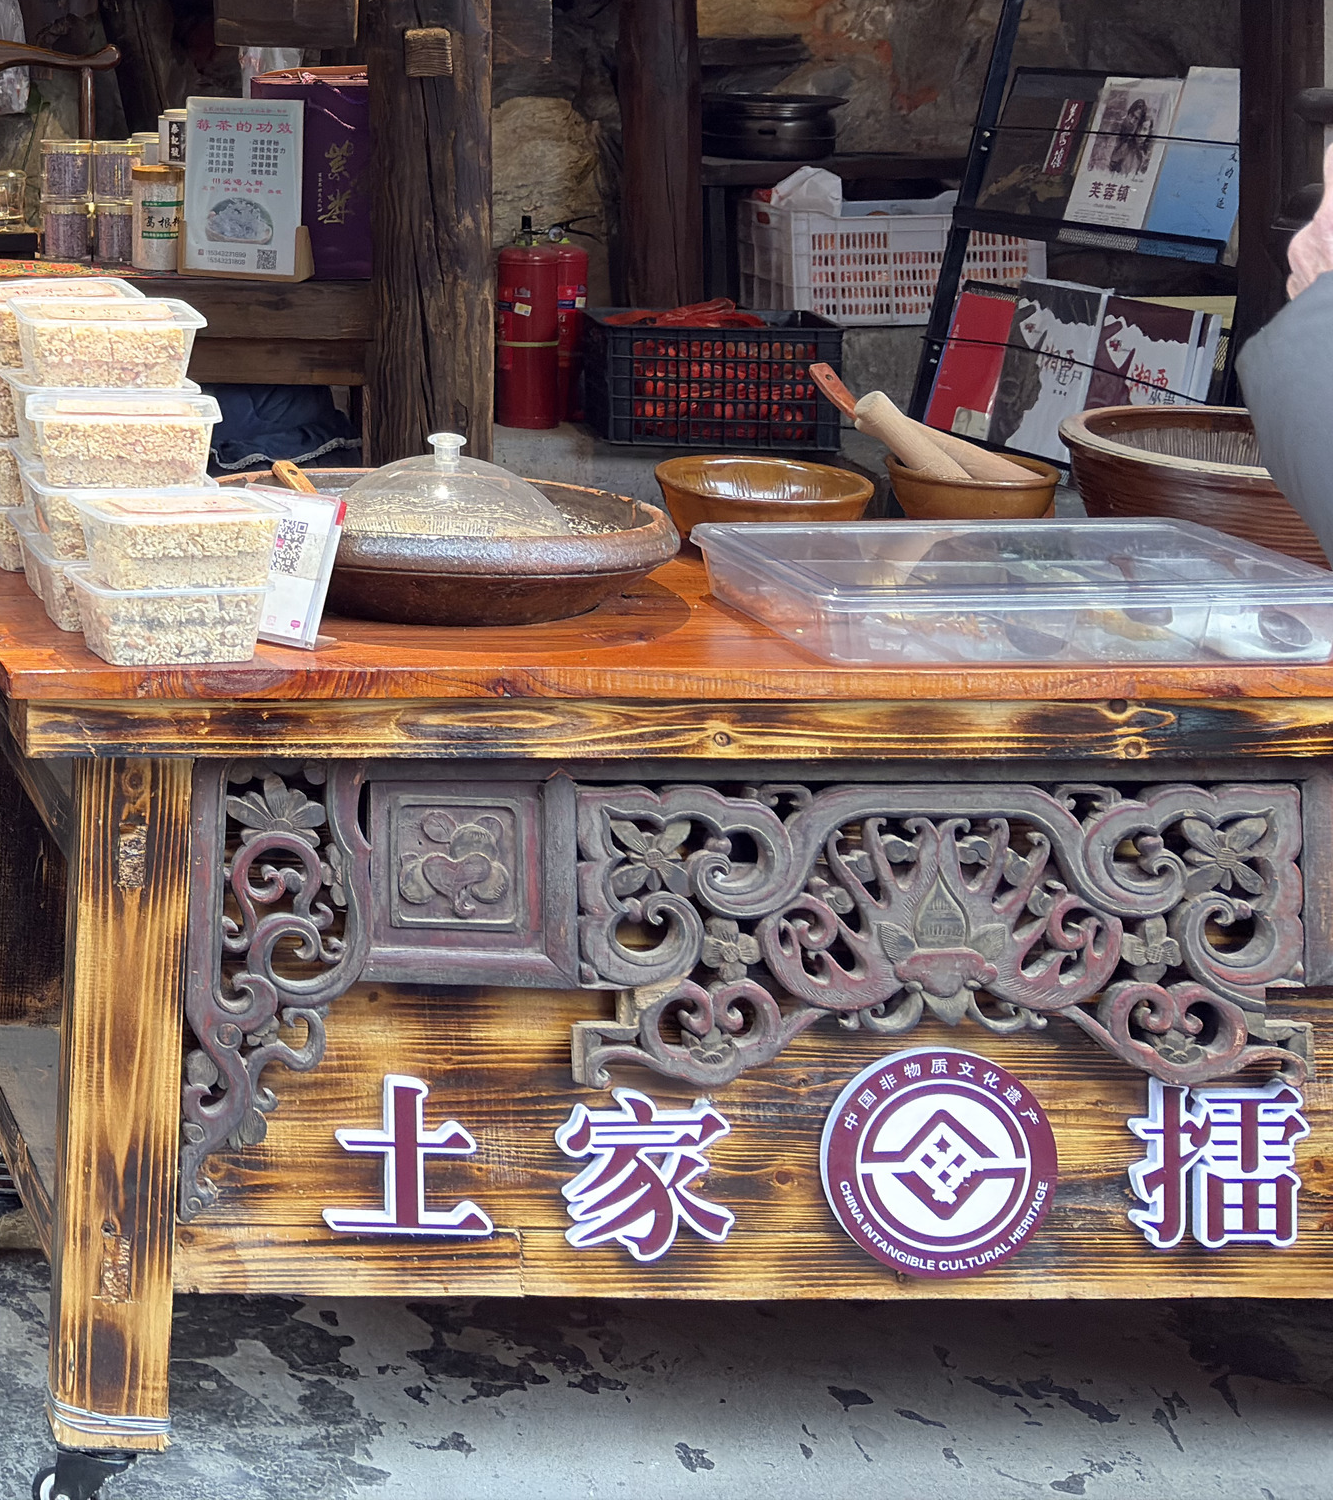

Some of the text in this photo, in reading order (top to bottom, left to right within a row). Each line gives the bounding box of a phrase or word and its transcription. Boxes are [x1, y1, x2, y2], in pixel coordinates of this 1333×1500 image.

[196, 119, 293, 135] 莓茶的功效
[1088, 181, 1131, 203] 芙蓉镇
[844, 1058, 1040, 1131] 中国非物质文化遗产
[839, 1181, 1049, 1271] CHINA INTANGIBLE CULTURAL HERITAGE
